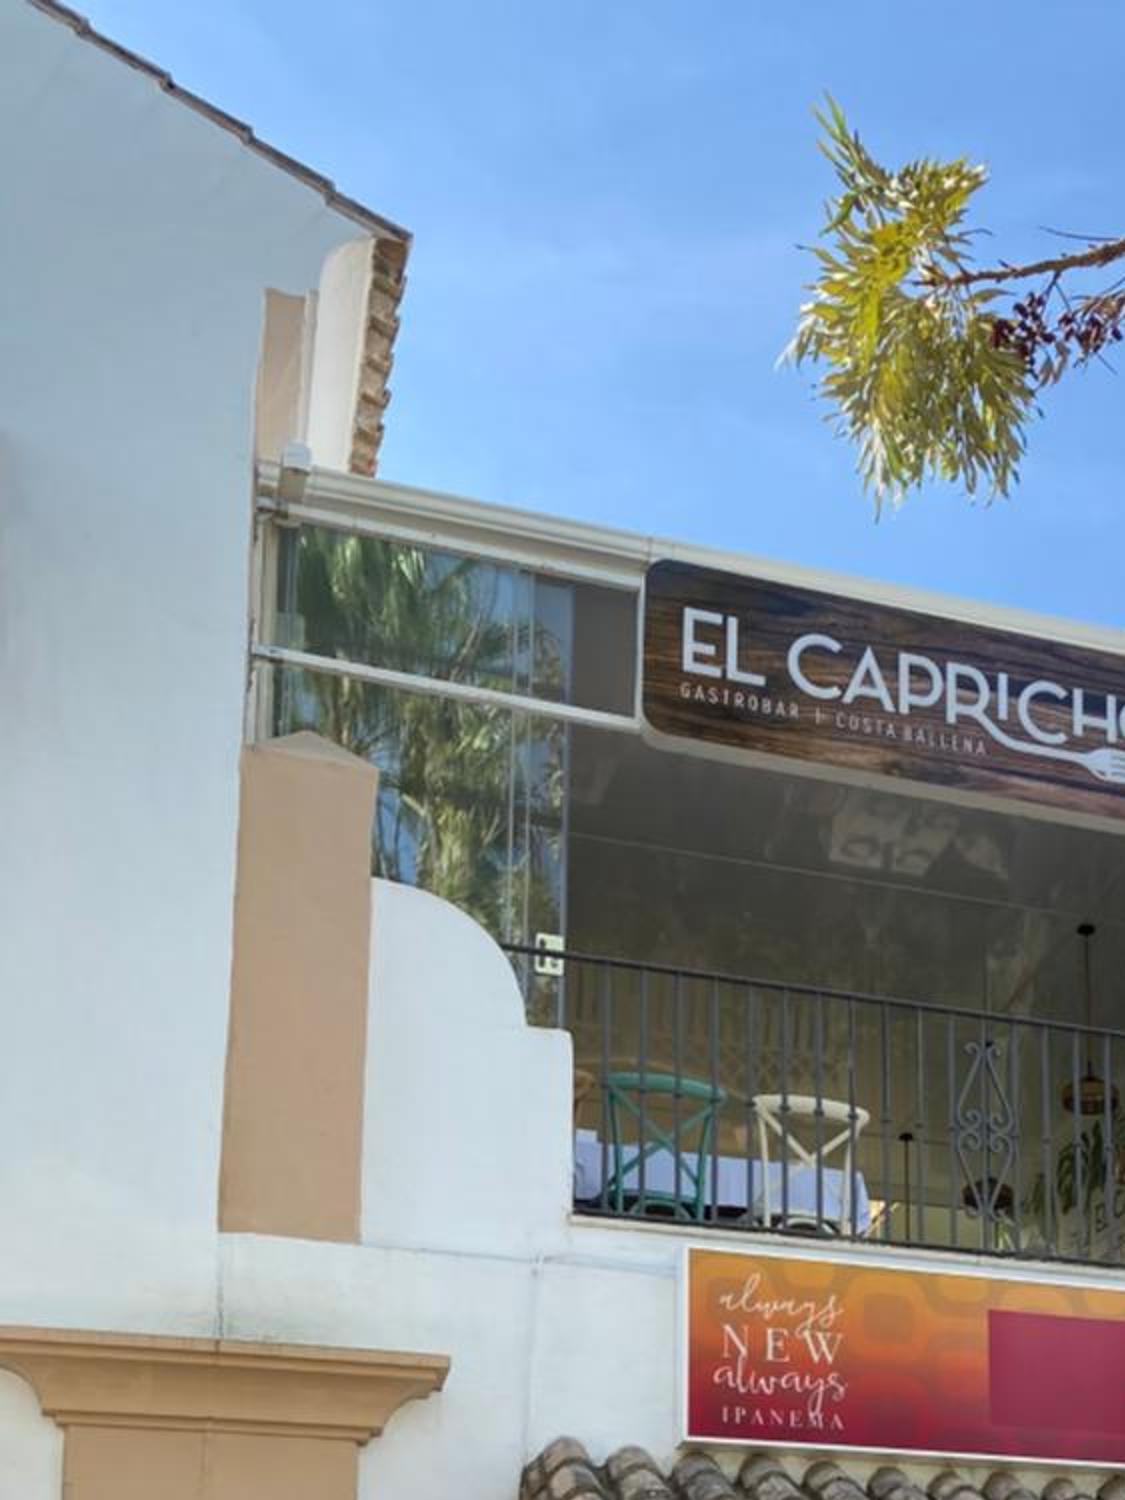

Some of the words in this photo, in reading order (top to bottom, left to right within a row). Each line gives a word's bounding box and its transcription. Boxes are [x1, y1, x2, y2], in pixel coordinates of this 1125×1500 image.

[683, 607, 766, 686] EL
[680, 682, 800, 719] GASTROBAR
[835, 711, 897, 738] COSTA
[904, 724, 987, 755] BALLENA
[719, 1272, 844, 1339] always
[722, 1323, 844, 1364] NEW
[713, 1354, 847, 1414] always
[722, 1405, 845, 1430] IPANEMA
